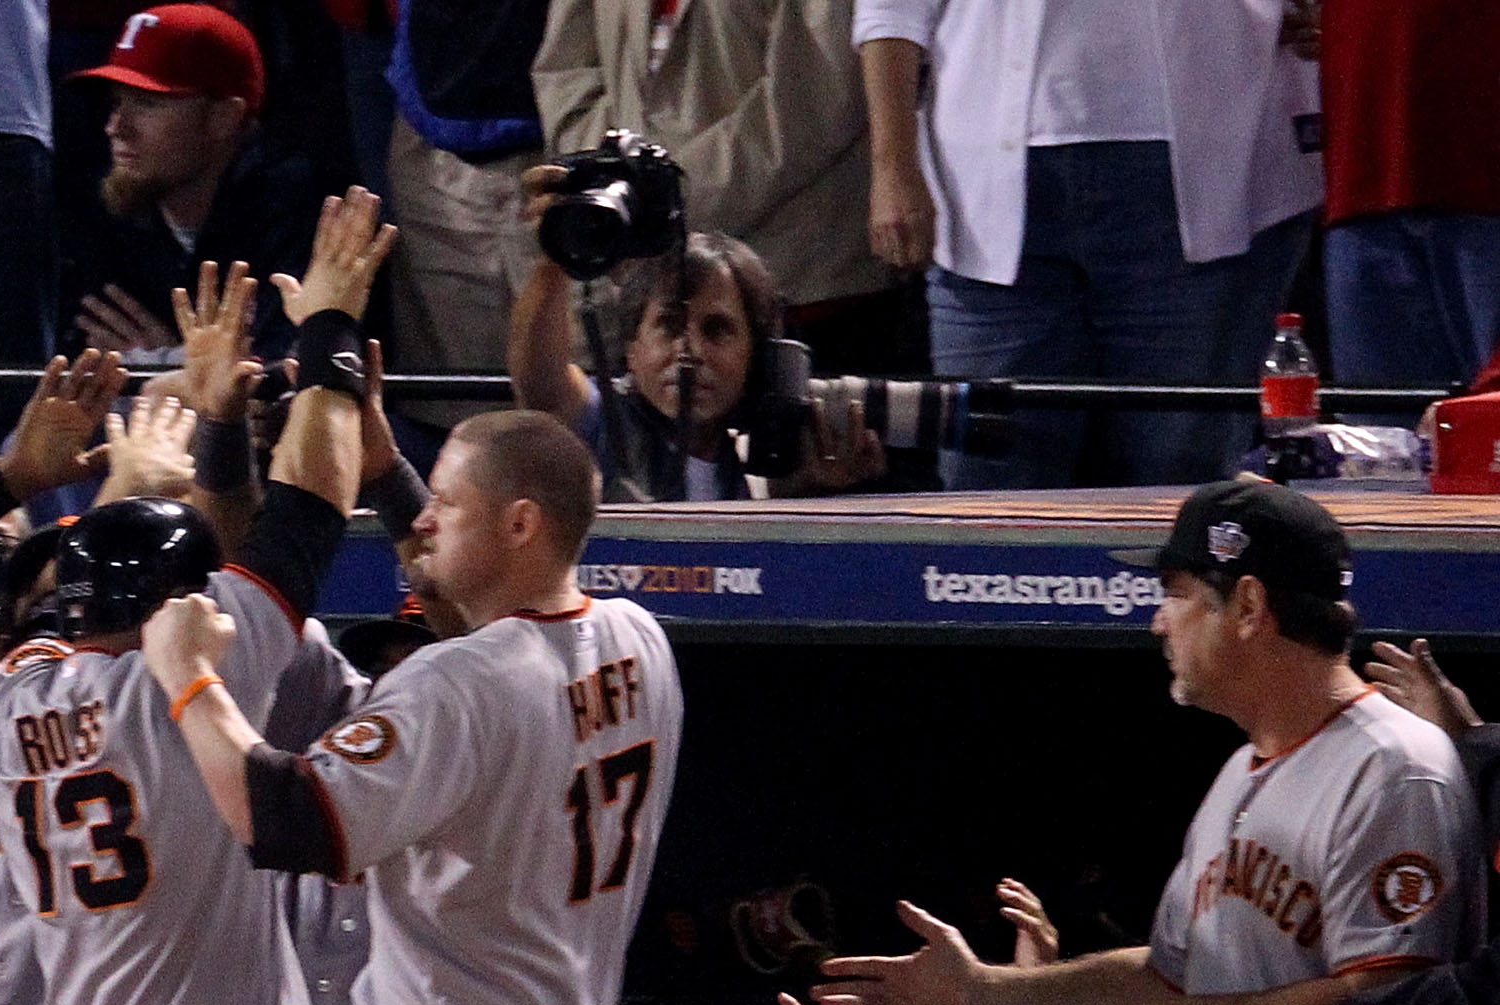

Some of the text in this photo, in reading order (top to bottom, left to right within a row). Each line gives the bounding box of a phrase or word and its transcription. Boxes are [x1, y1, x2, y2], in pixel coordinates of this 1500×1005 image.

[115, 12, 160, 49] T
[58, 581, 94, 600] OSS
[642, 565, 713, 592] 2010
[713, 566, 764, 594] FOX
[14, 768, 154, 917] 13
[564, 737, 658, 906] 17
[1198, 837, 1325, 949] FANCISCO
